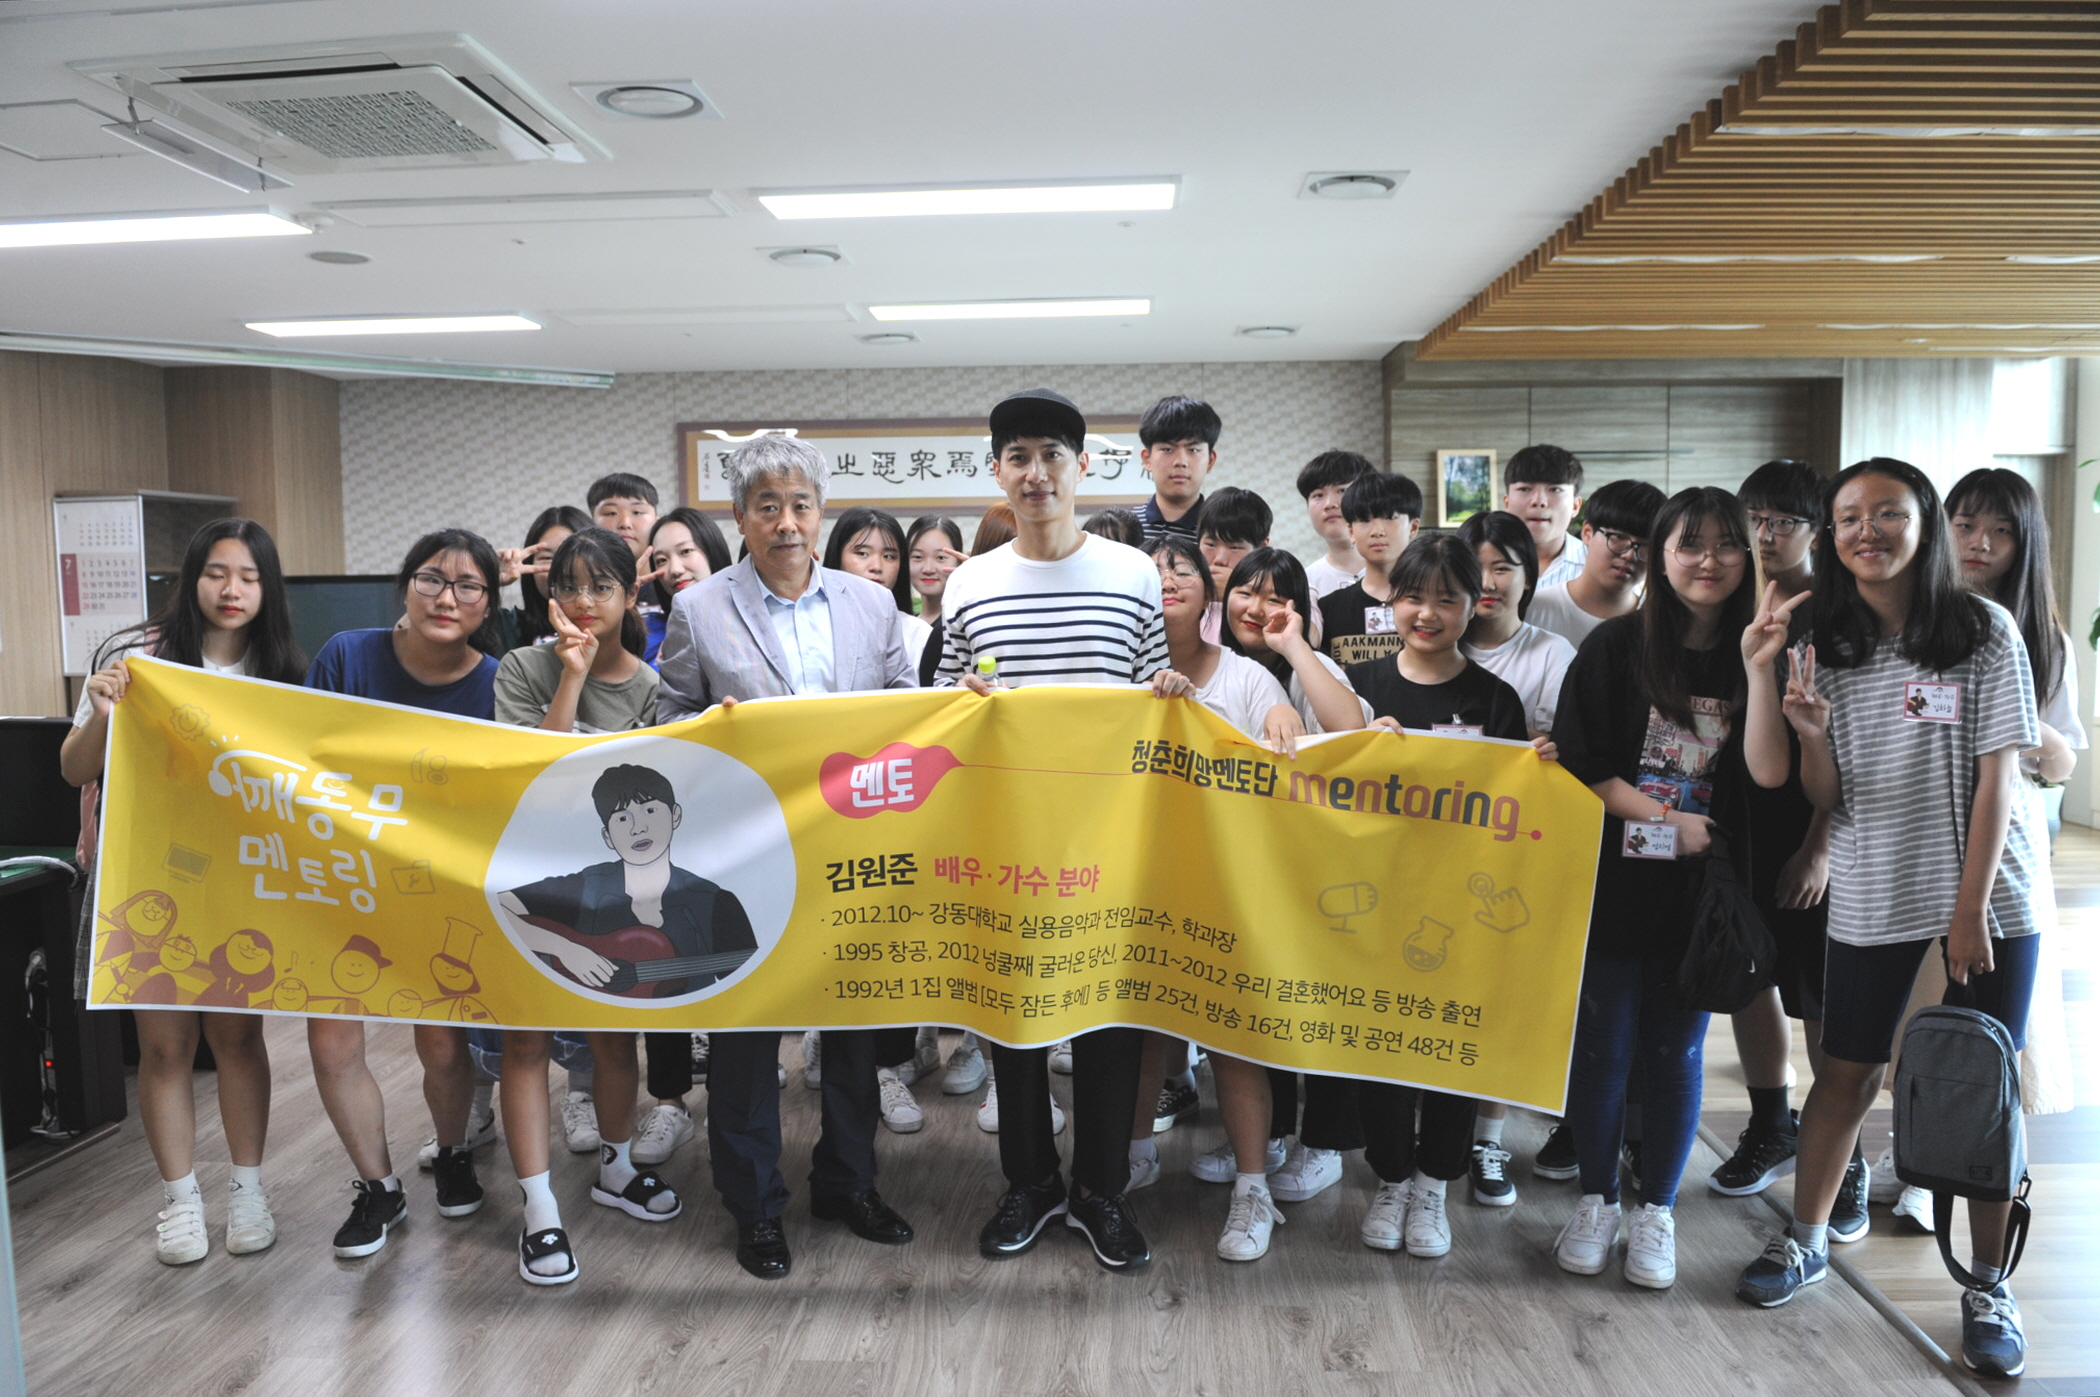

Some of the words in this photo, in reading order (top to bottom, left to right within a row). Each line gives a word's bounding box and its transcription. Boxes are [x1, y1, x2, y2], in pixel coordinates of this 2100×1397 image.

[1693, 698, 1731, 714] EGAS
[208, 750, 408, 840] 어깨동무
[850, 758, 916, 808] 멘토
[1132, 739, 1278, 797] 청춘희망멘토단
[239, 832, 377, 914] 멘토링
[826, 853, 918, 893] 김원준
[1056, 865, 1100, 897] 분야
[832, 905, 923, 926] 2012.10~
[930, 903, 1012, 933] 강동대학교
[1019, 910, 1101, 939] 실용음악과
[1104, 907, 1175, 934] 전임교수,
[1183, 918, 1237, 953] 학과장
[834, 943, 883, 961] 1995
[938, 942, 979, 964] 2012
[983, 949, 1033, 977] 넝쿨째
[1039, 951, 1085, 978] 굴러온
[1122, 943, 1228, 987] 2011~2012
[1232, 974, 1272, 998] 우리
[1276, 980, 1366, 1006] 결혼했어요
[1372, 990, 1391, 1013] 등
[1397, 993, 1436, 1019] 방송
[1441, 1000, 1481, 1027] 출연
[836, 978, 903, 999] 1992년
[911, 977, 940, 997] 1집
[1020, 994, 1056, 1017] 잠든
[1096, 980, 1110, 1002] 등
[1115, 979, 1151, 1001] 앨범
[1206, 1000, 1241, 1028] 방송
[1300, 1021, 1335, 1043] 영화
[1341, 1025, 1359, 1048] 및
[1364, 1028, 1403, 1053] 공연
[1407, 1036, 1453, 1061] 48건
[1459, 1043, 1478, 1066] 등
